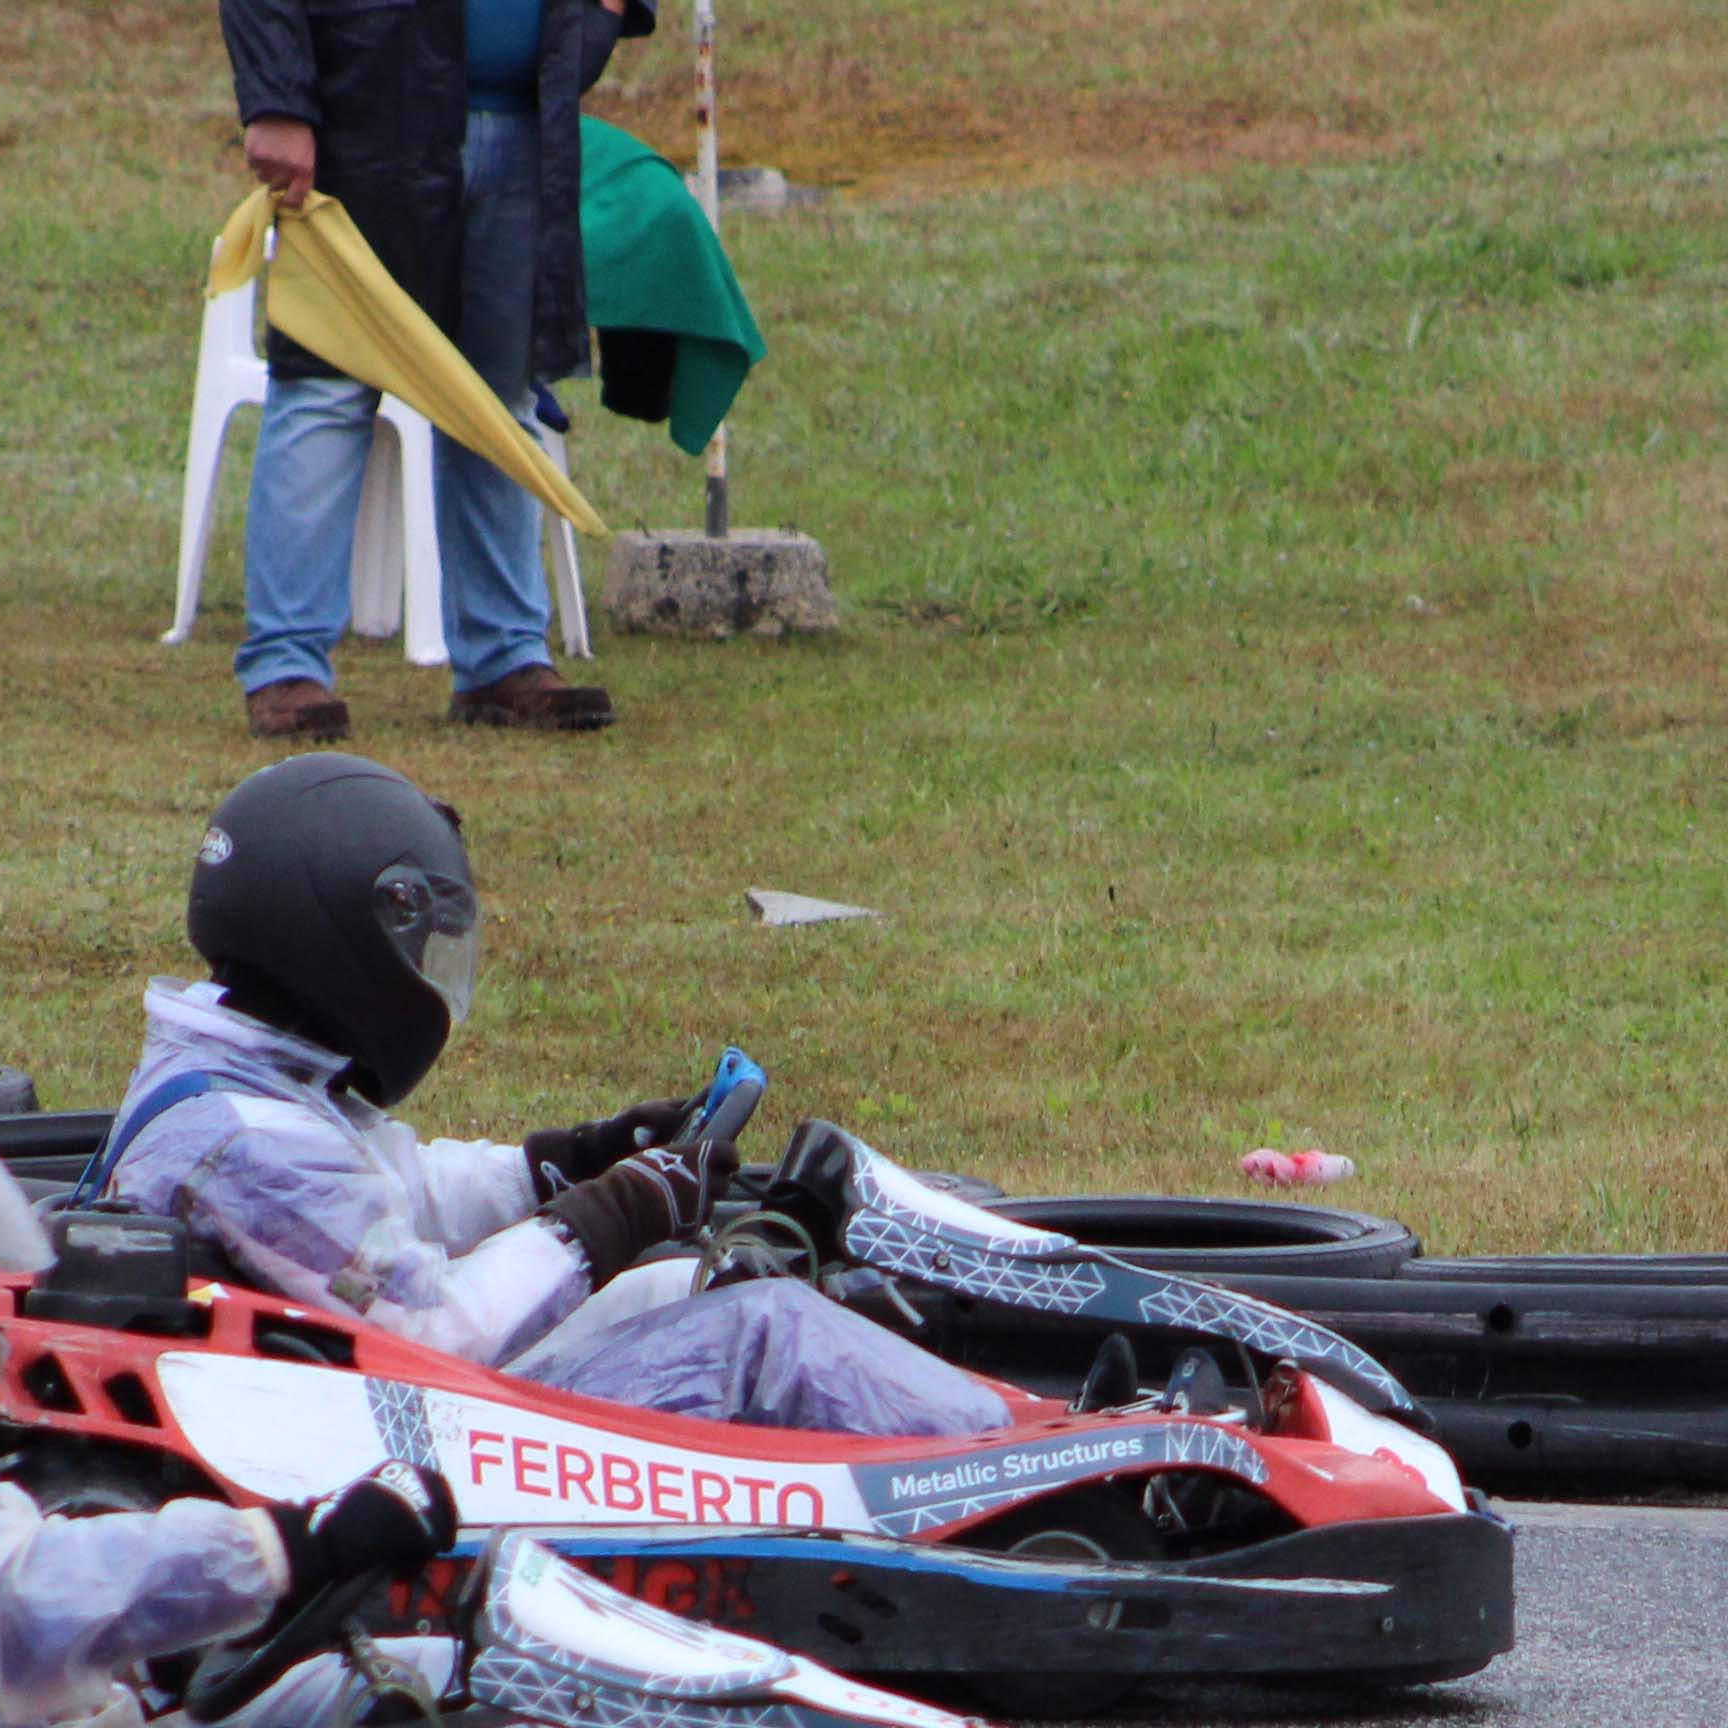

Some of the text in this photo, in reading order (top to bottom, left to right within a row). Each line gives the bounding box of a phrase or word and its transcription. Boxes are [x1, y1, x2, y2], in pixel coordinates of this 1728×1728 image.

[470, 1432, 824, 1526] FERBERTO
[890, 1433, 1144, 1502] Metallic Structures
